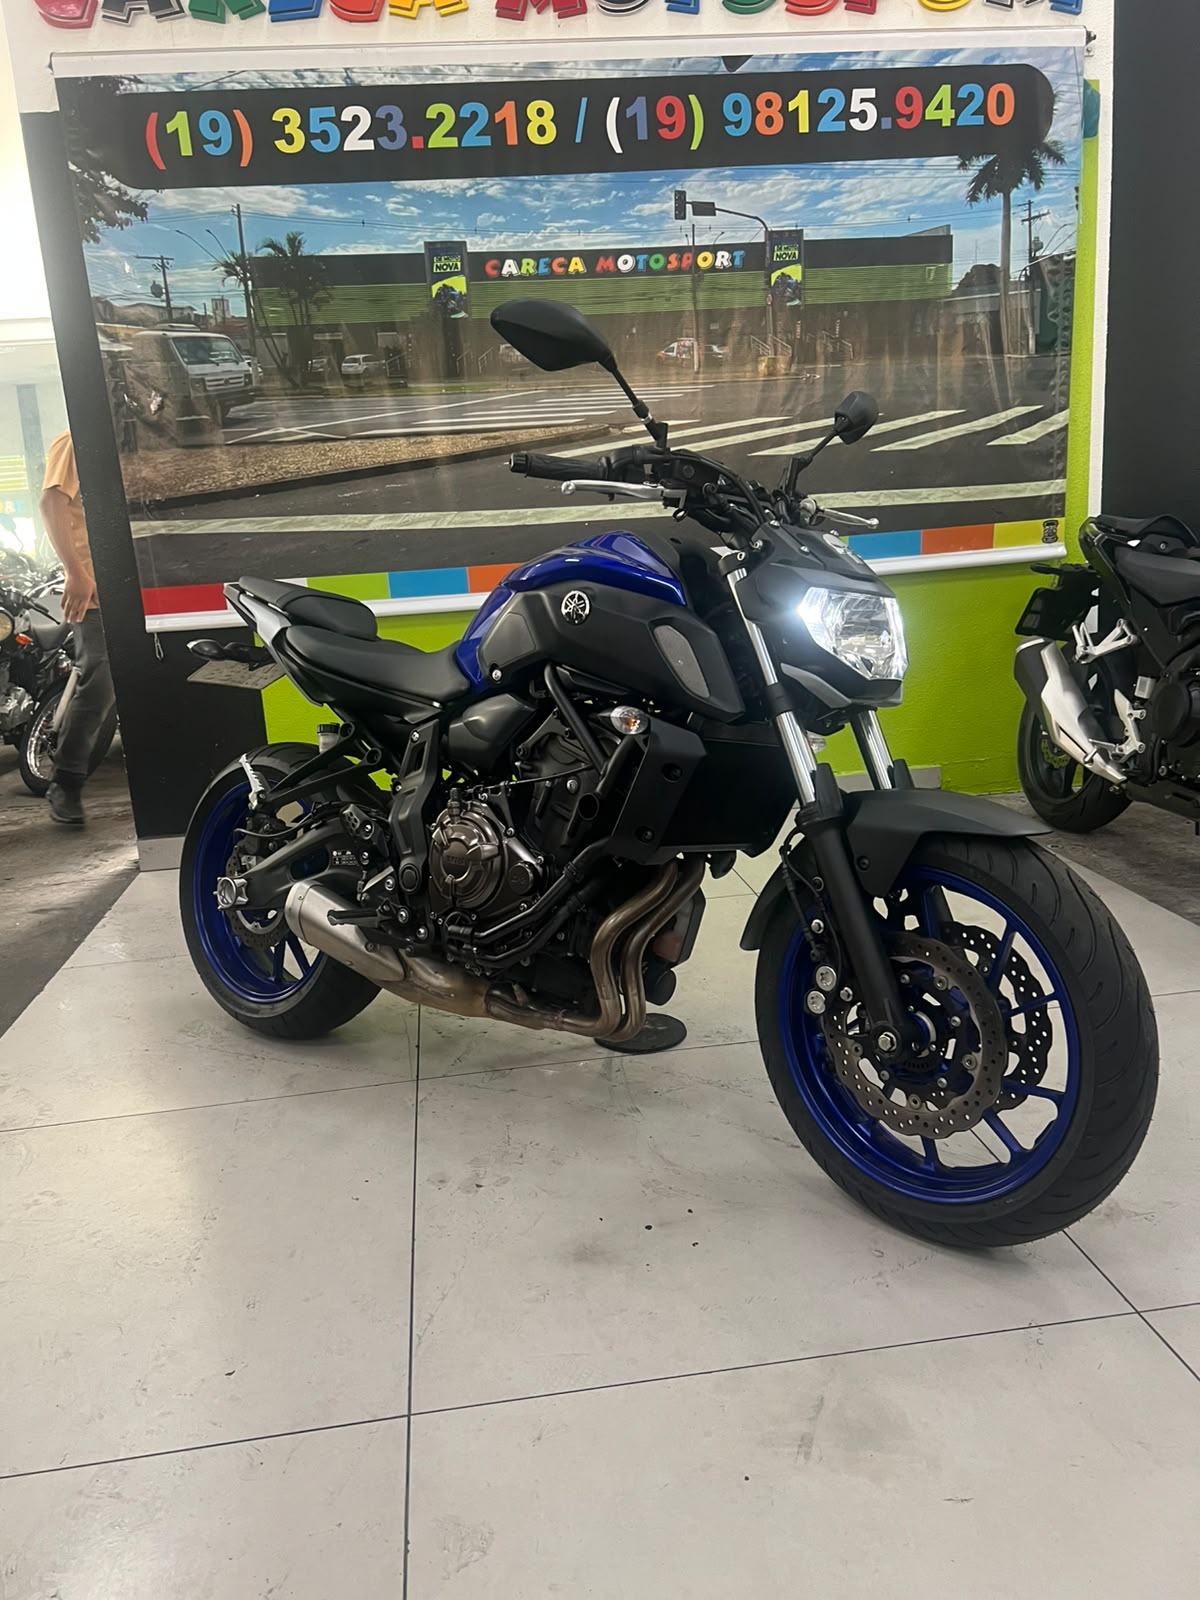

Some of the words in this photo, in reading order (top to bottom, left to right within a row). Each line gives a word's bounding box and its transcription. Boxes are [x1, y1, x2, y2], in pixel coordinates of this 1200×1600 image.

[145, 109, 253, 170] (19)
[271, 99, 557, 155] 3523.2218
[574, 97, 588, 144] /
[605, 94, 704, 154] (19)
[723, 83, 1015, 137] 98125.9420
[484, 257, 587, 278] CARECA
[595, 251, 745, 273] MOTOSPORT
[775, 251, 797, 261] NOVA
[434, 262, 460, 272] NOVA
